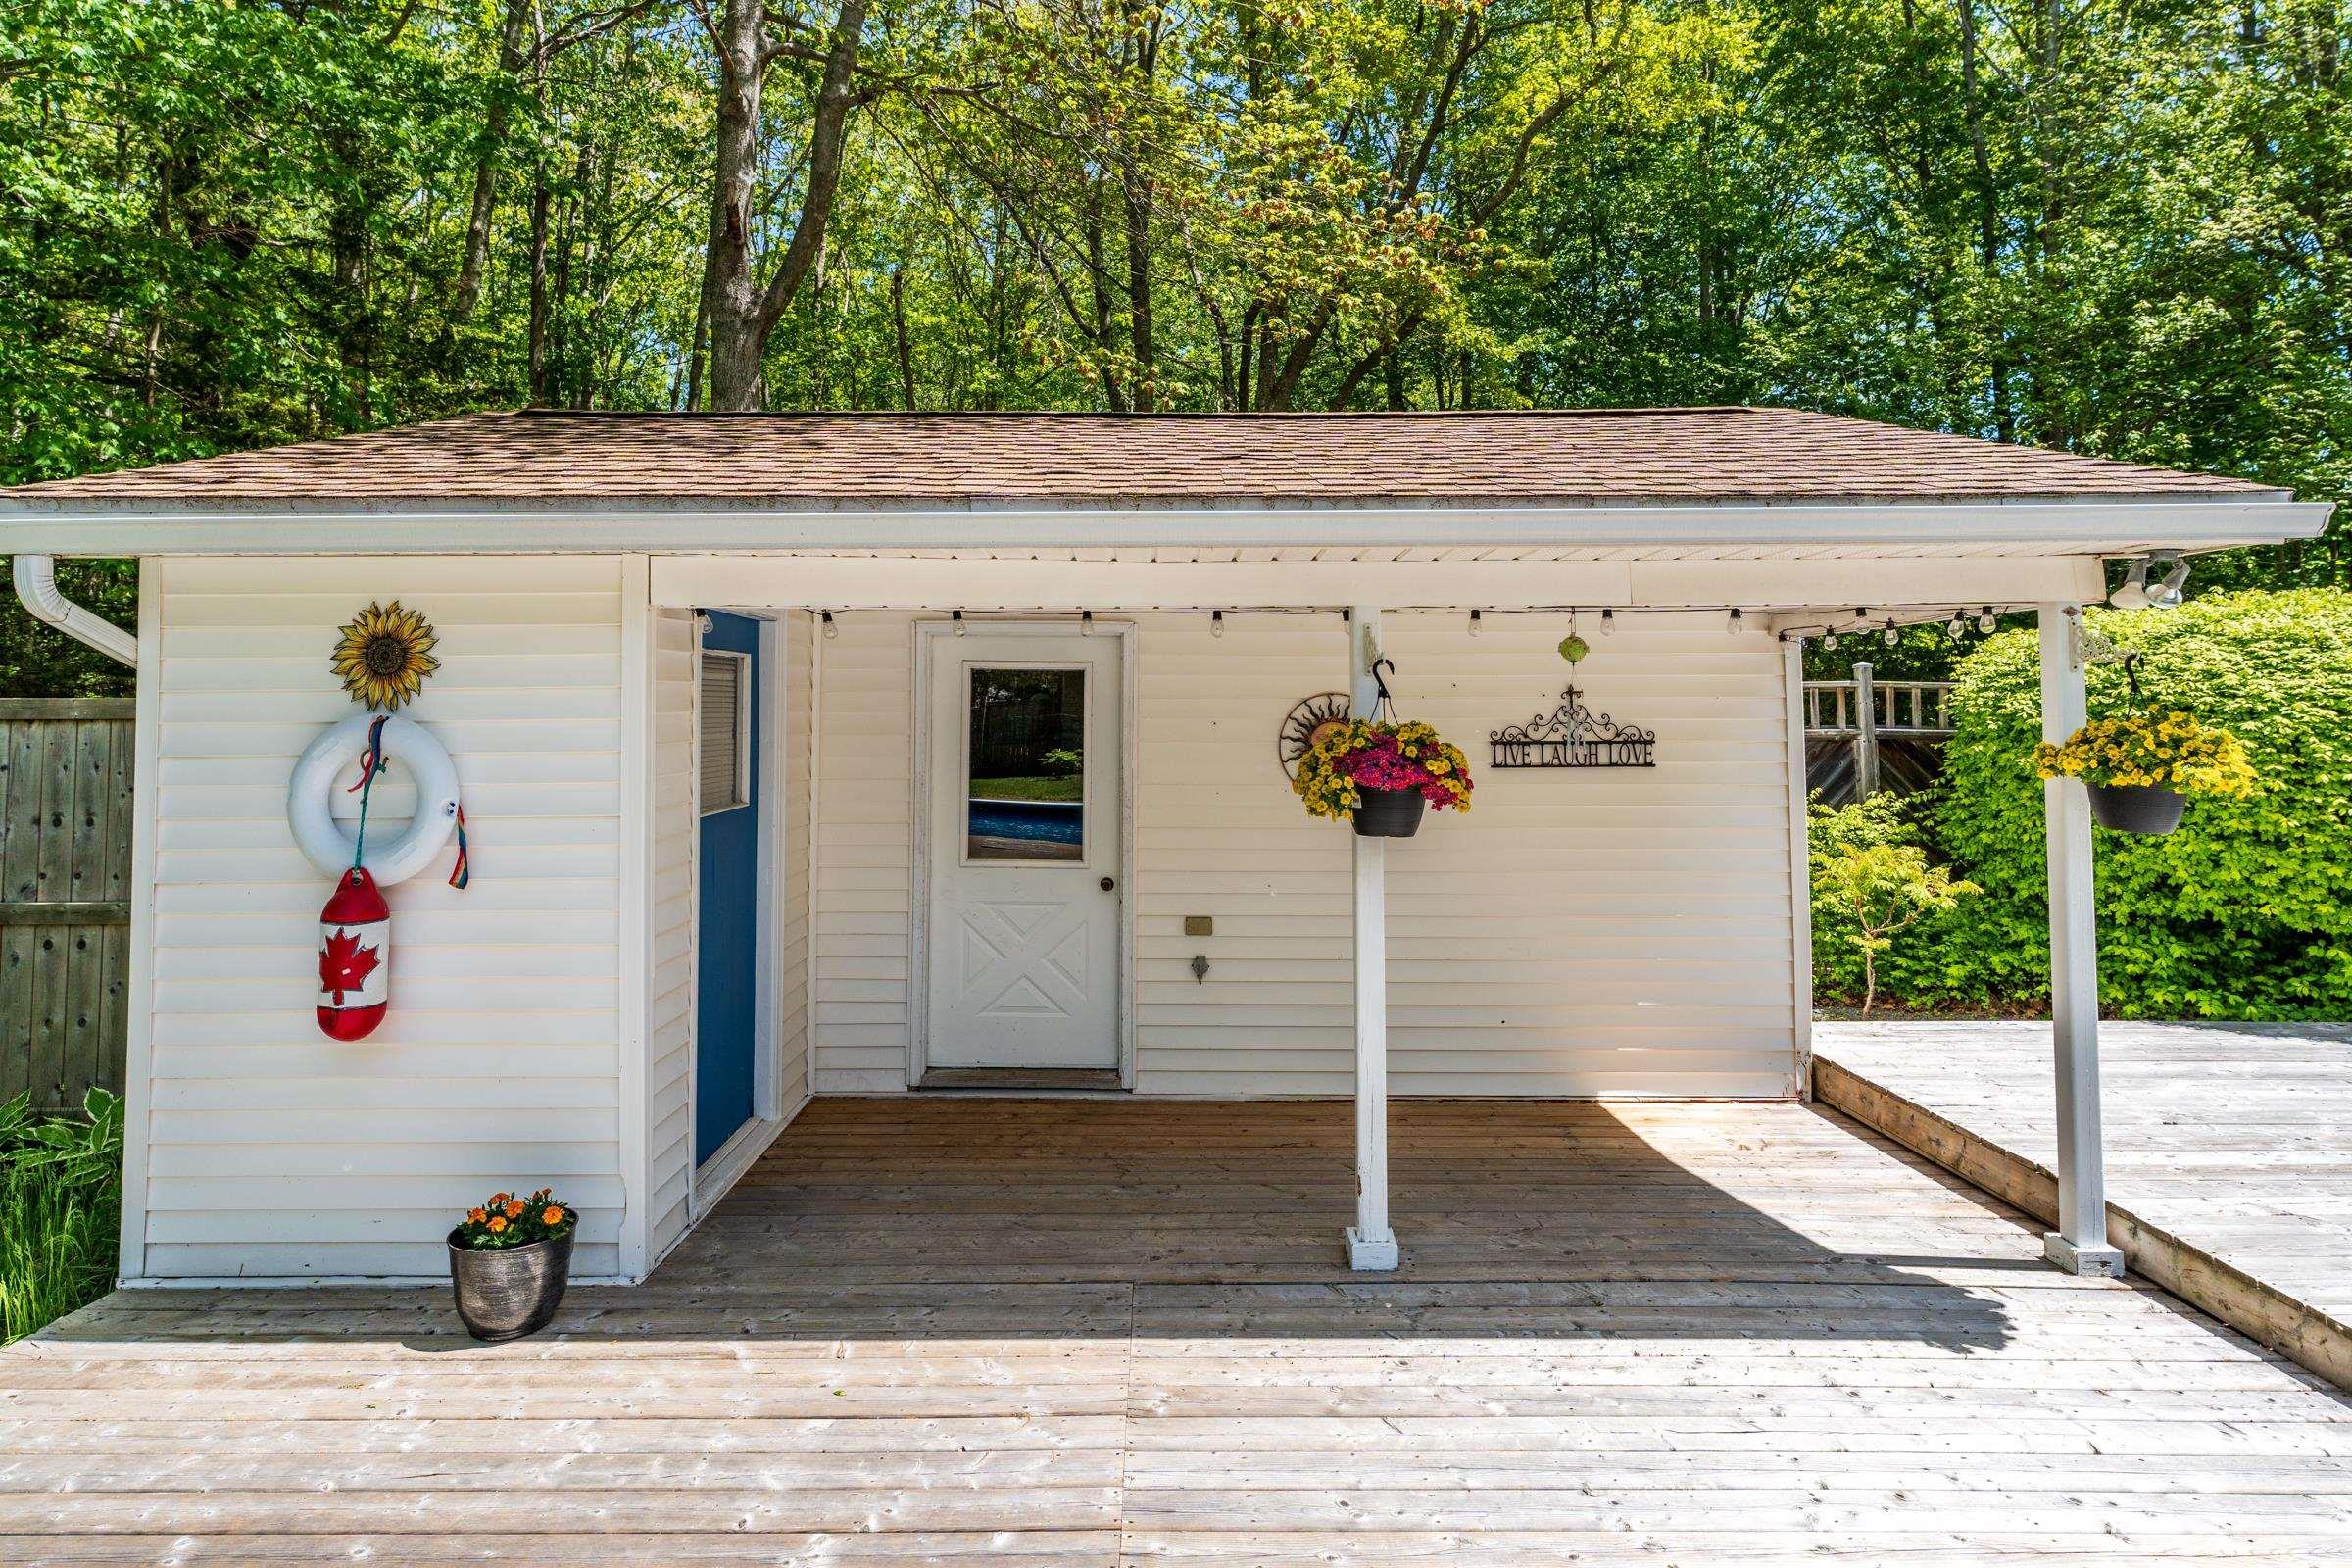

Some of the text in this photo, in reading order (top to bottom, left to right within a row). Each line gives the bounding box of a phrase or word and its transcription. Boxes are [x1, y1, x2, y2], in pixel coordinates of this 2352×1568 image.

[1493, 742, 1655, 766] LIVE LAUGH LOVE
